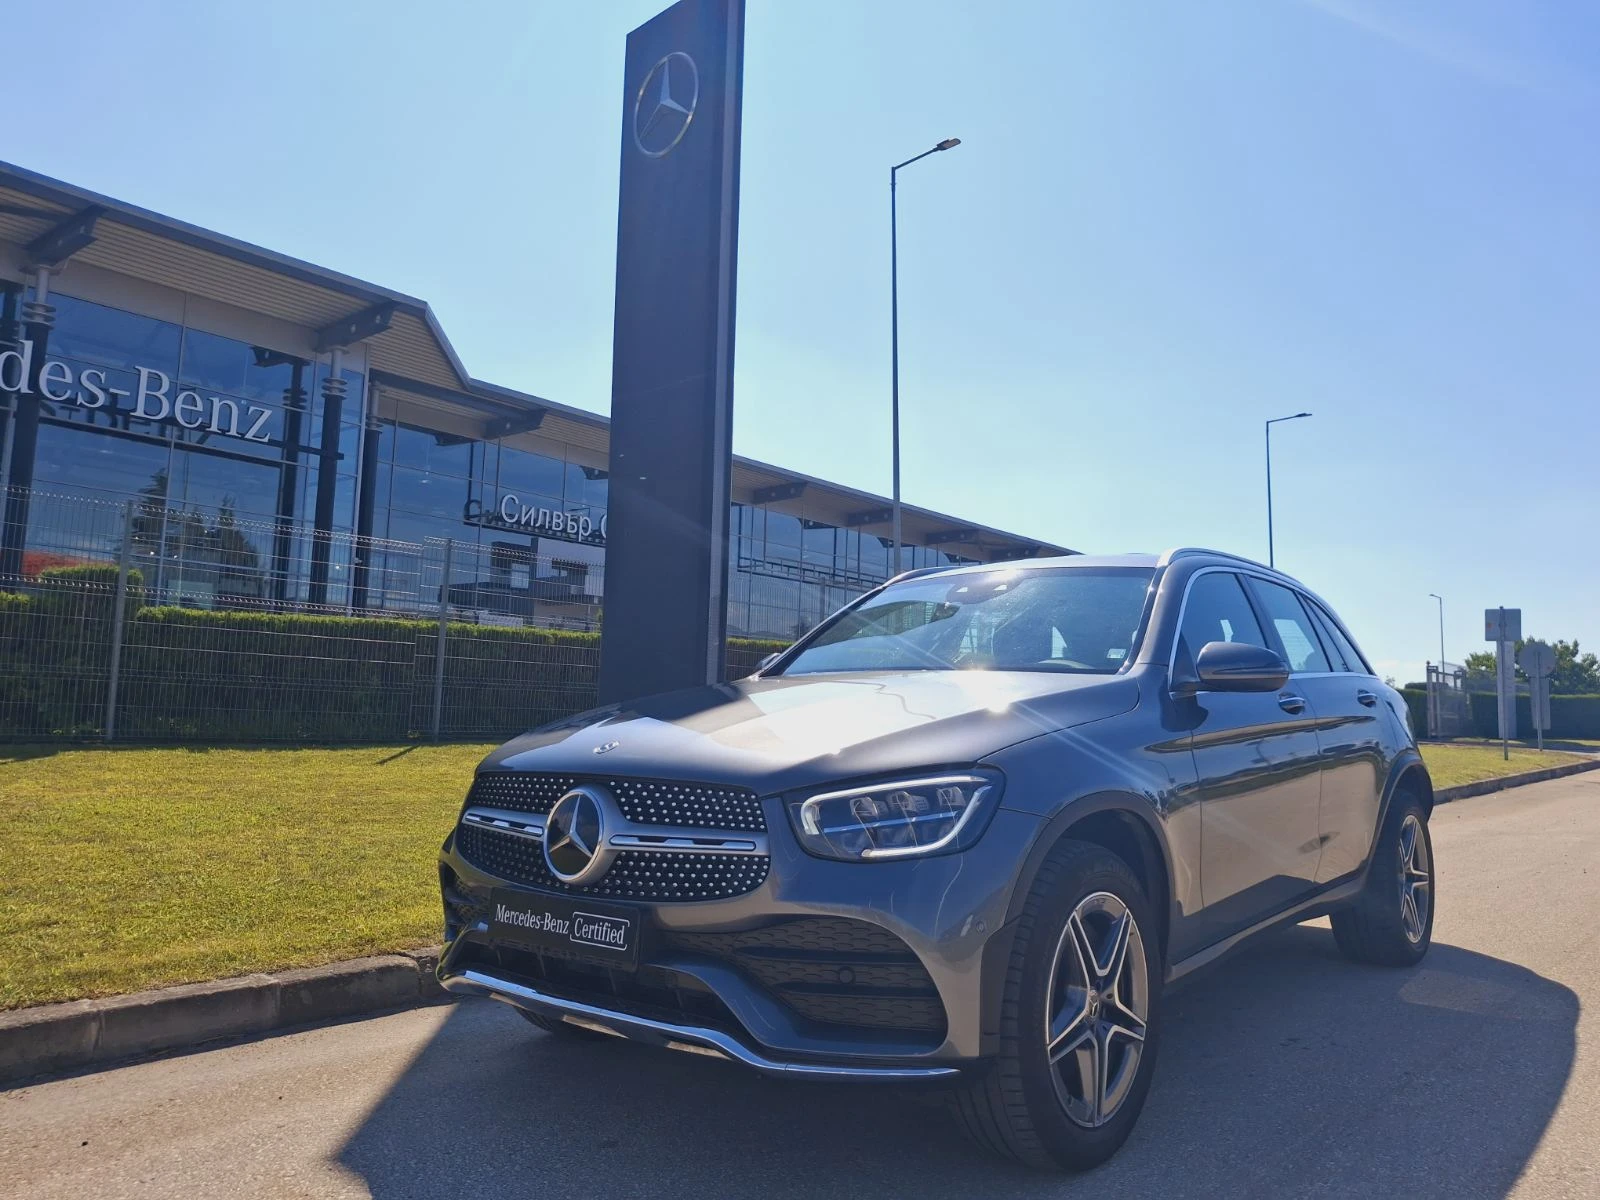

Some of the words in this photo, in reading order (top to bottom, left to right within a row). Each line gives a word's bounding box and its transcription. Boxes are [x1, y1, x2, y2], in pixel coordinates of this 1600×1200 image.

[500, 493, 592, 542] Силвър
[494, 903, 570, 935] Mercedes-Benz
[574, 917, 625, 945] Certified
